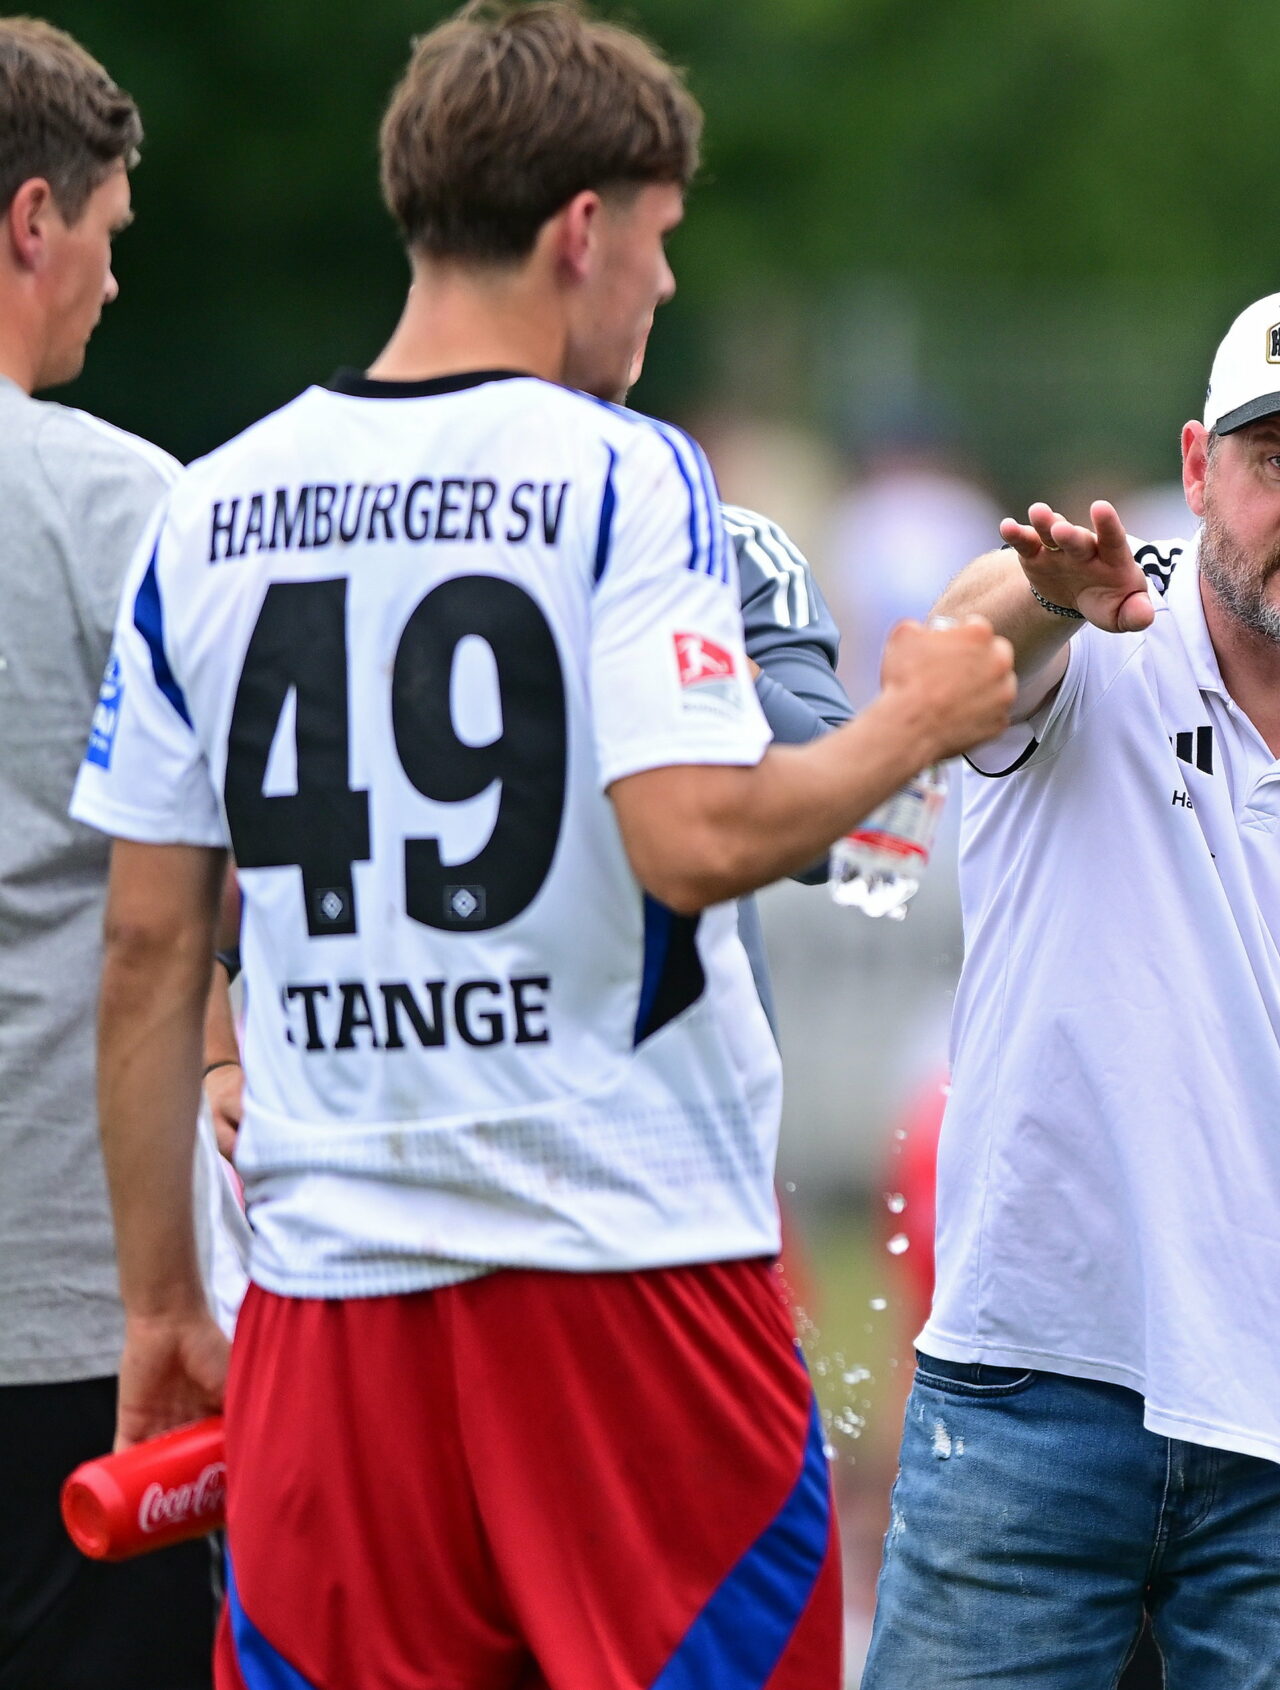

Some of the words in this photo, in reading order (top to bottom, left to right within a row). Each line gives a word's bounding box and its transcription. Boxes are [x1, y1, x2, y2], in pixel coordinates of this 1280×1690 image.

[208, 480, 498, 563] HAMBURGER
[506, 482, 569, 546] SV
[224, 575, 569, 937] 49
[280, 973, 551, 1054] TANGE
